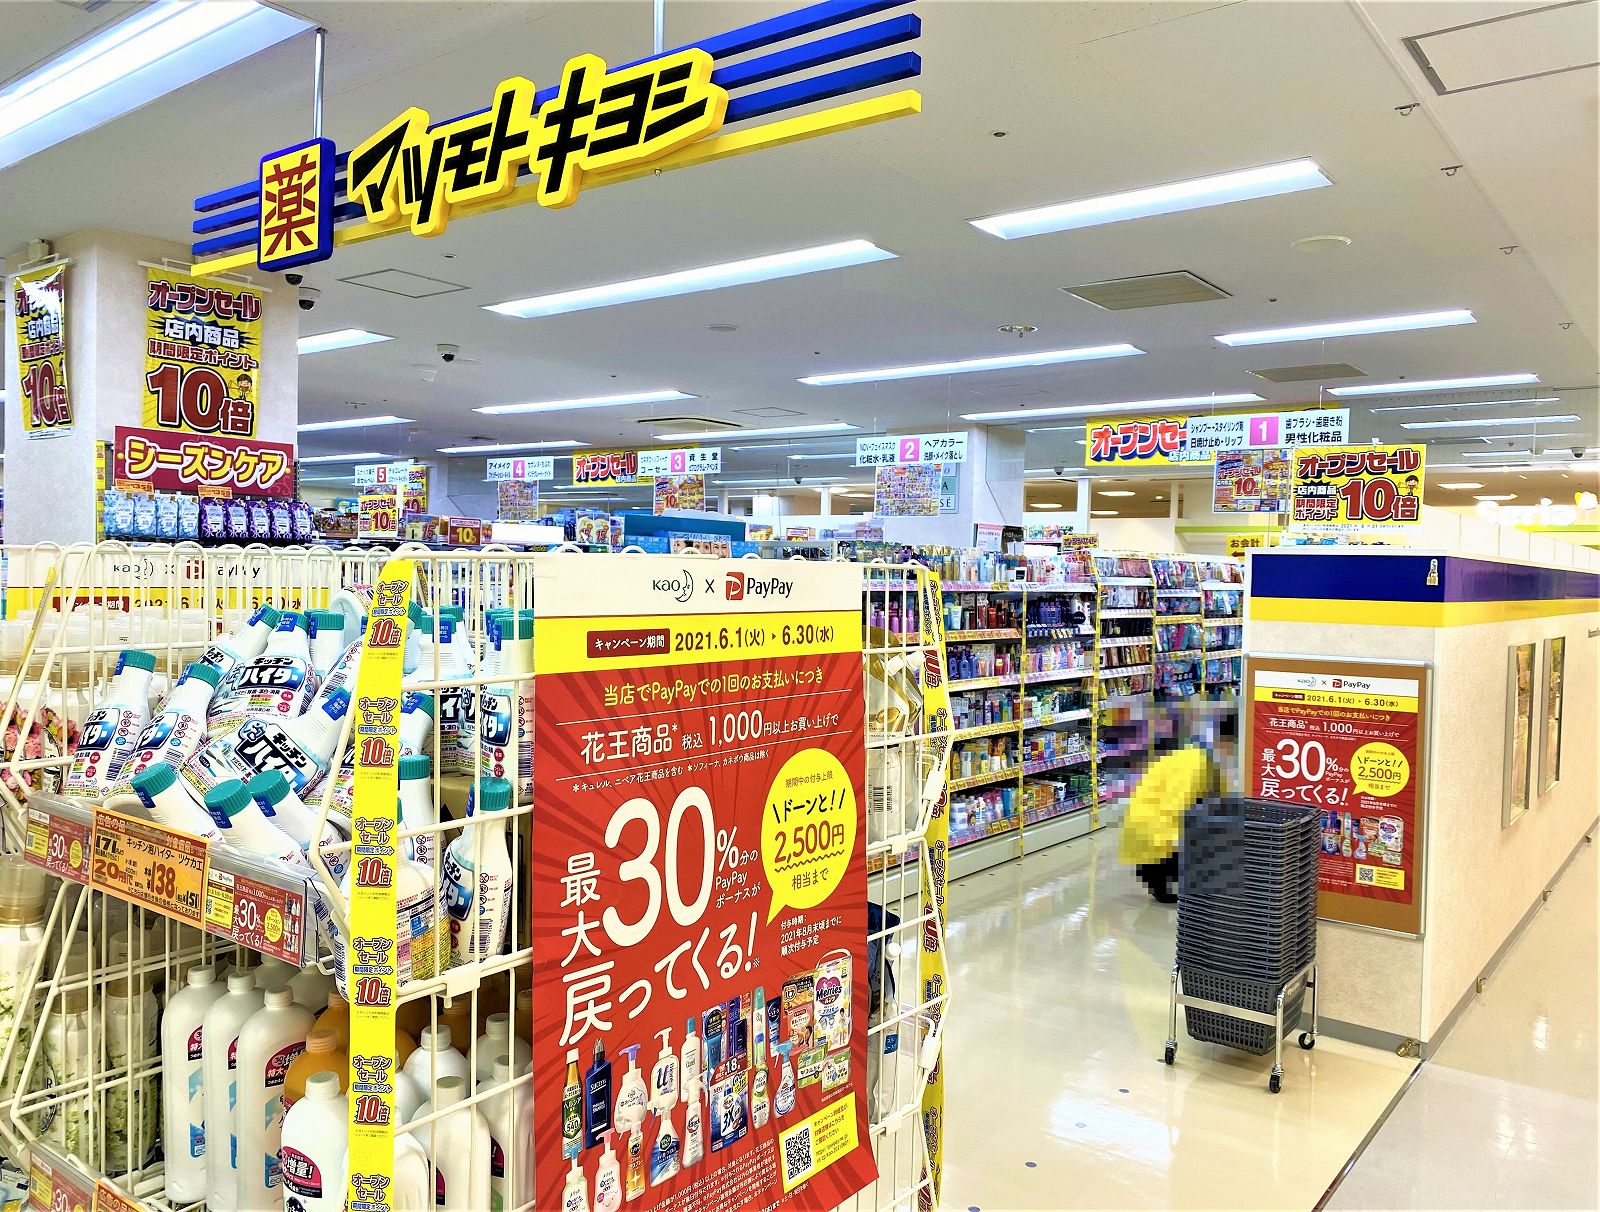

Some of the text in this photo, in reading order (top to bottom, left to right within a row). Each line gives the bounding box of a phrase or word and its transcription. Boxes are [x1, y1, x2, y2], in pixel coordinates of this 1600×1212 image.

[353, 61, 709, 225] マツモトキヨシ
[264, 154, 317, 257] 薬
[148, 280, 262, 320] オープンセール
[164, 317, 241, 349] 店内商品
[148, 339, 258, 370] 期間限定ポイント
[147, 363, 254, 435] 10倍
[1258, 420, 1267, 442] 1
[1285, 416, 1343, 430] 歯ブラシ・歯磨き粉
[924, 438, 964, 448] ヘアカラー
[1091, 420, 1187, 458] オープンセー
[1190, 436, 1243, 449] 日焼け止め・リップ
[1285, 431, 1342, 445] 男性化粧品
[859, 453, 896, 464] 化粧水・乳液
[904, 441, 915, 459] 2
[923, 450, 963, 461] 洗顔・メイク落とし
[126, 437, 287, 488] シーズンケア
[489, 462, 511, 470] アイメイク
[515, 461, 523, 477] 4
[575, 452, 637, 481] オープンセール
[641, 466, 668, 474] コーセー
[674, 454, 682, 470] 3
[1297, 449, 1421, 479] オープンセール
[378, 468, 385, 483] 5
[1297, 485, 1337, 496] 店内商品
[1340, 478, 1419, 520] 10倍
[1295, 498, 1338, 510] 期間限定
[1295, 509, 1338, 520] ポイント
[1230, 538, 1260, 548] お会計
[375, 579, 408, 594] オープン
[746, 577, 794, 599] PayPay
[377, 595, 403, 606] セール
[369, 618, 402, 648] 10倍
[594, 634, 665, 651] キャンペーン期間
[253, 657, 294, 666] キッチン
[240, 666, 299, 685] ハイター
[604, 665, 823, 707] 当店でPayPayでの1回のお支払いにつき
[1343, 680, 1371, 690] PayPay
[359, 697, 398, 711] オープン
[363, 710, 393, 724] セール
[272, 732, 307, 768] キッチン
[681, 732, 703, 751] 税込
[359, 737, 395, 767] 10倍
[1262, 748, 1276, 777] 最大
[1358, 766, 1402, 781] 2,500円
[1368, 782, 1391, 791] 相当まで
[97, 813, 126, 832] 広告の品
[355, 817, 395, 831] オープン
[360, 831, 390, 844] セール
[774, 820, 845, 864] 2,500円
[126, 837, 175, 860] キッチン泡ハイター
[178, 853, 203, 872] ツケカエ
[739, 849, 758, 867] 分の
[357, 857, 392, 887] 10倍
[715, 870, 748, 891] PayPay
[791, 868, 829, 890] 相当まで
[715, 883, 761, 909] ボーナスが
[560, 851, 602, 968] 最大
[780, 916, 842, 944] 2021年8月末頃までに
[353, 937, 393, 951] オープン
[780, 934, 820, 957] 順次付与予定
[358, 950, 389, 963] セール
[355, 977, 391, 1006] 10倍
[816, 985, 843, 1002] Merries
[353, 1055, 392, 1069] オープン
[357, 1069, 388, 1082] セール
[355, 1095, 390, 1125] 10倍
[286, 1154, 315, 1180] 増量!
[352, 1173, 390, 1188] オープン
[100, 1188, 128, 1211] 広告の品
[356, 1187, 385, 1201] セール
